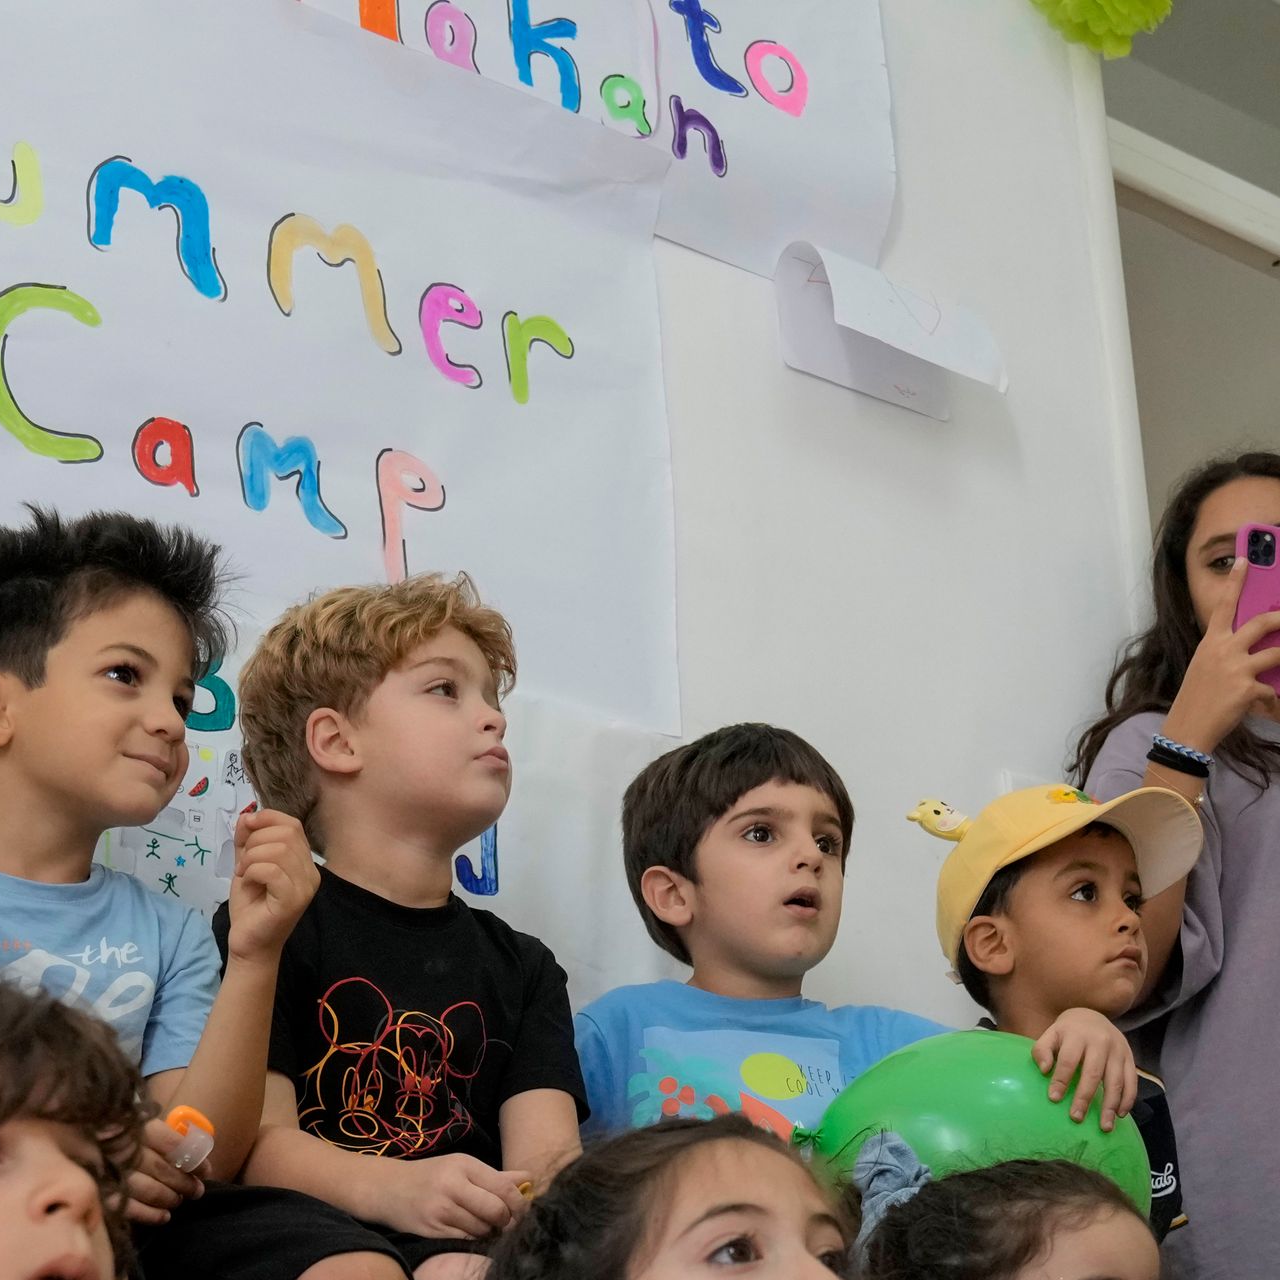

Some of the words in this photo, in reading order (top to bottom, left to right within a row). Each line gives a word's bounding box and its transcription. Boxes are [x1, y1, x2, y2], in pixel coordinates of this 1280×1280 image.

[669, 0, 809, 117] to
[65, 936, 145, 968] the
[785, 1077, 824, 1098] COOL
[797, 1063, 831, 1086] KEEP
